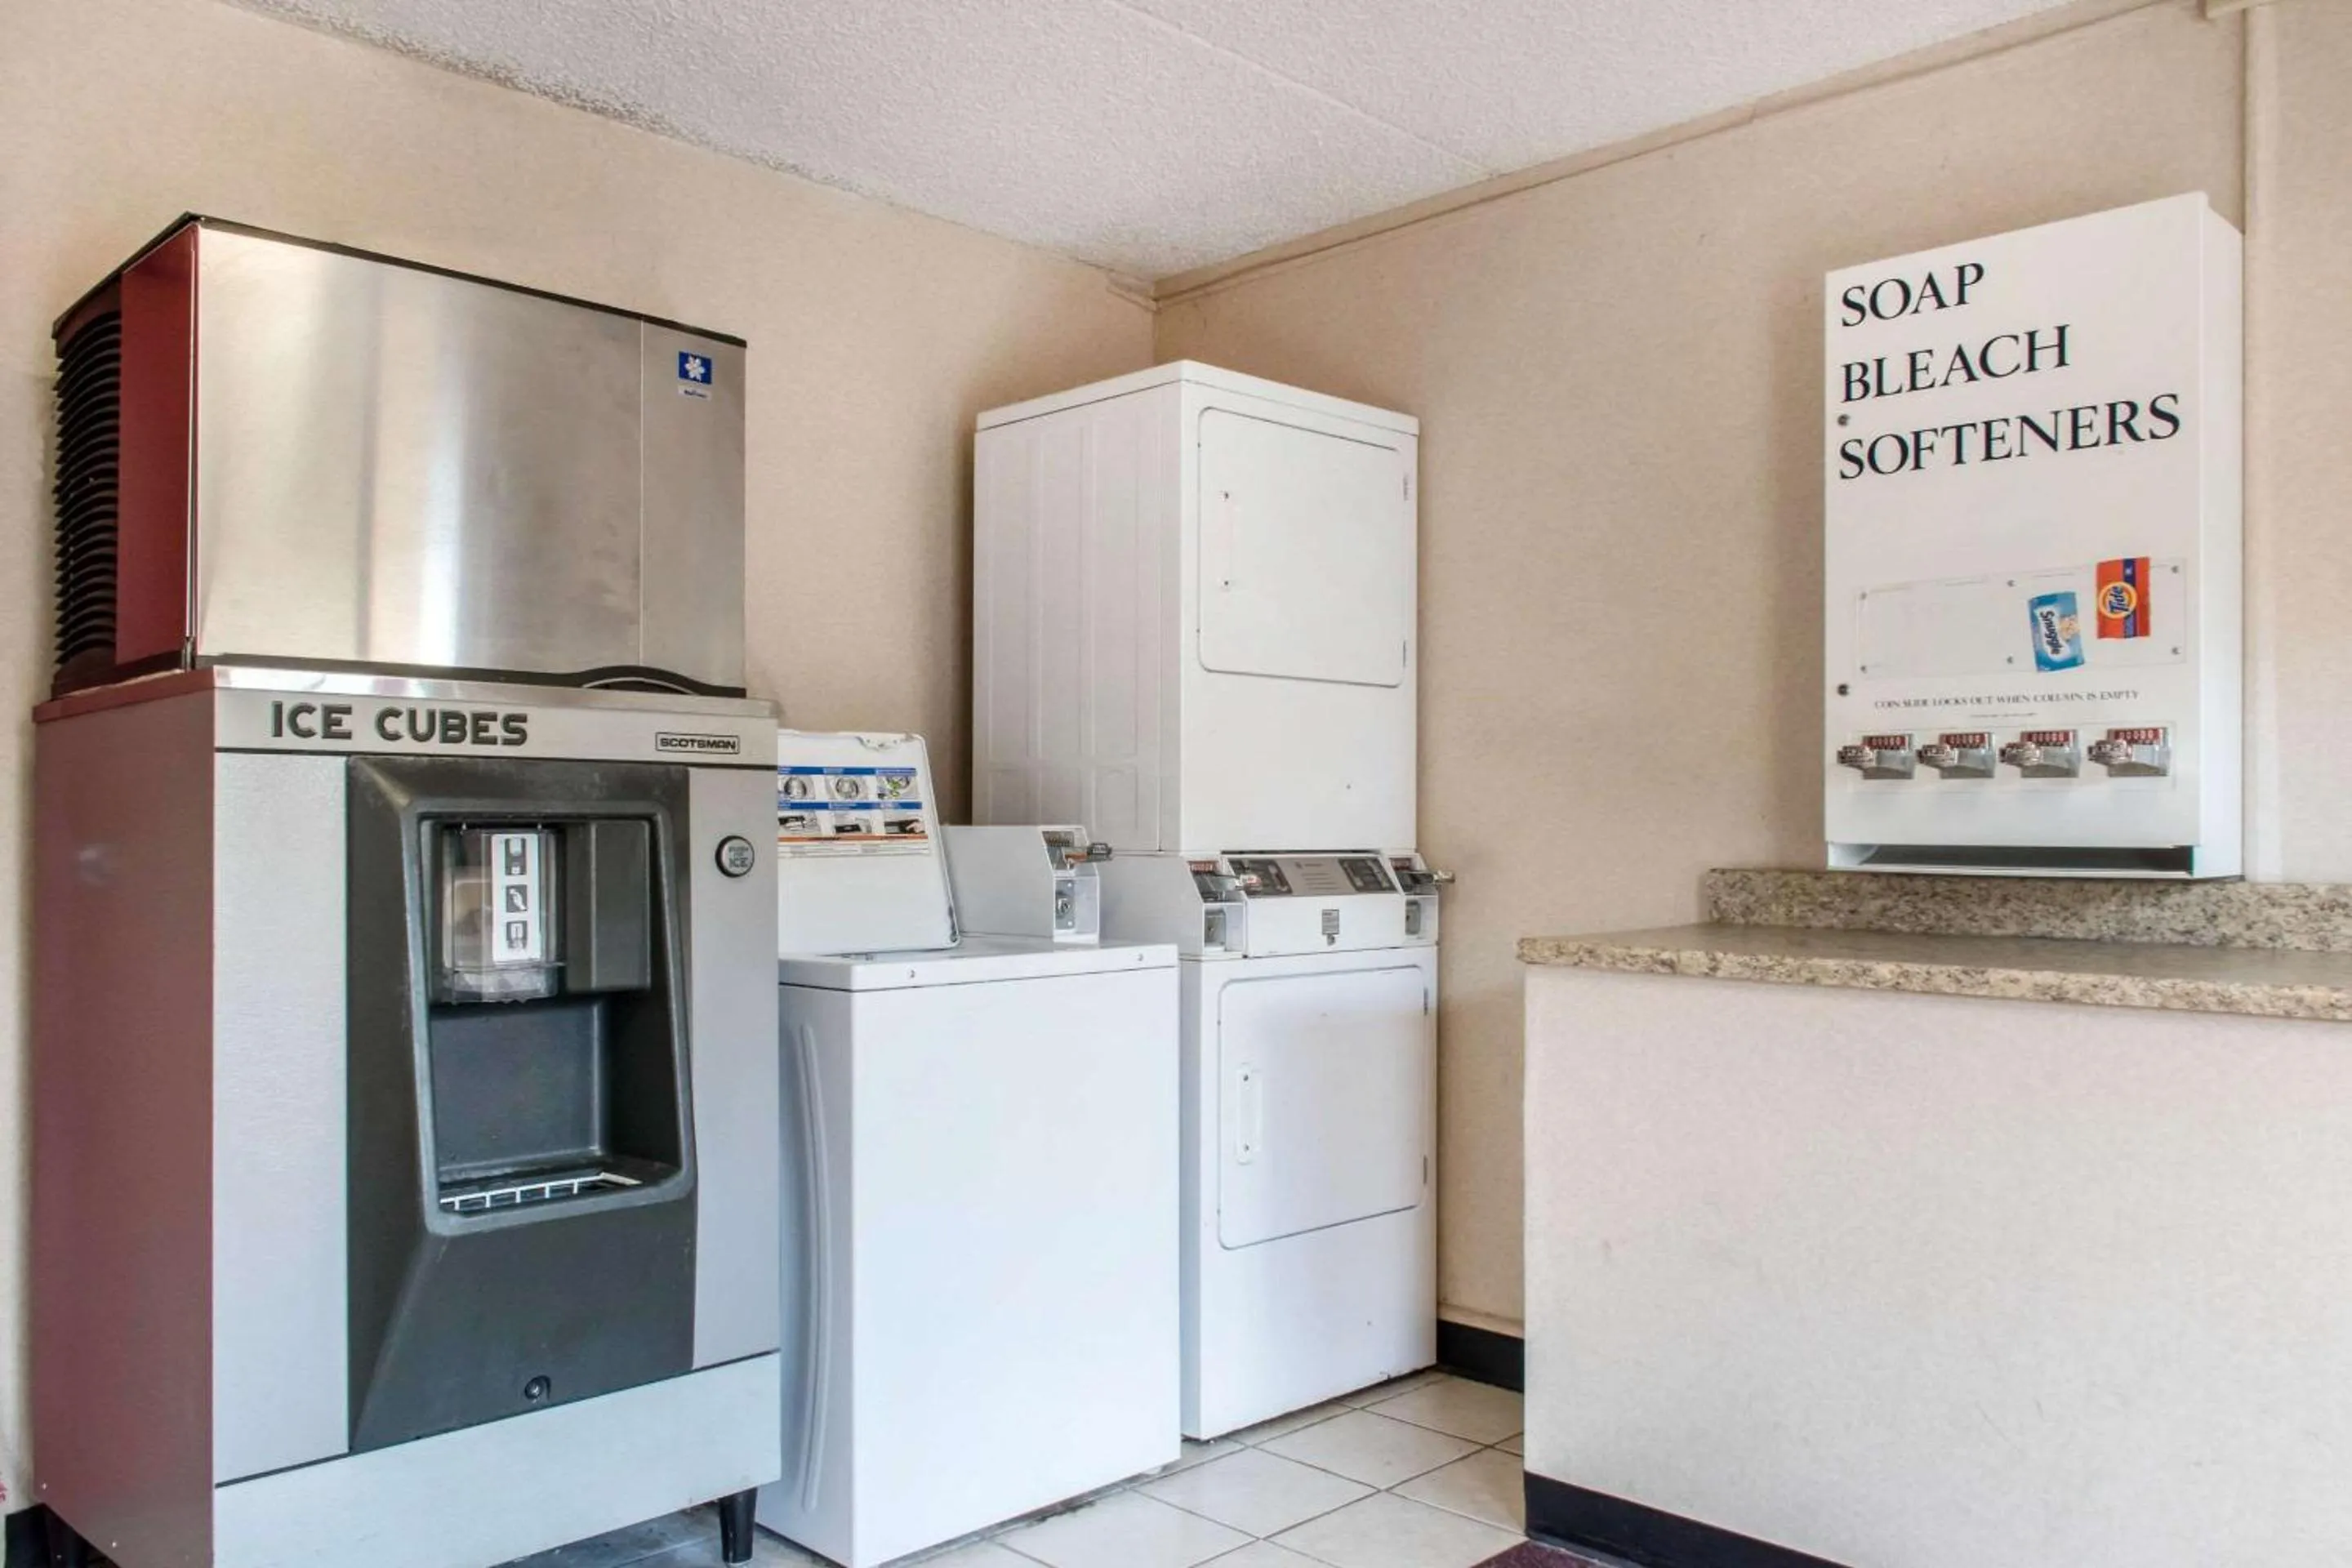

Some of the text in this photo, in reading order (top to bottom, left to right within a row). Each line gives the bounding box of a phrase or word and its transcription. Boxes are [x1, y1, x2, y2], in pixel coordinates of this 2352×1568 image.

[1841, 263, 1985, 327] SOAP
[1841, 324, 2070, 403] BLEACH
[1839, 394, 2180, 479] SOFTENERS
[2108, 585, 2129, 613] Tide
[2040, 611, 2064, 655] Snuggle
[1932, 697, 1967, 706] LOCKS
[1970, 696, 1993, 705] OUT
[1997, 694, 2029, 703] WHEN
[2100, 690, 2138, 700] EMPTY
[271, 701, 528, 747] ICE CUBES
[660, 737, 736, 749] SCOTSMAN
